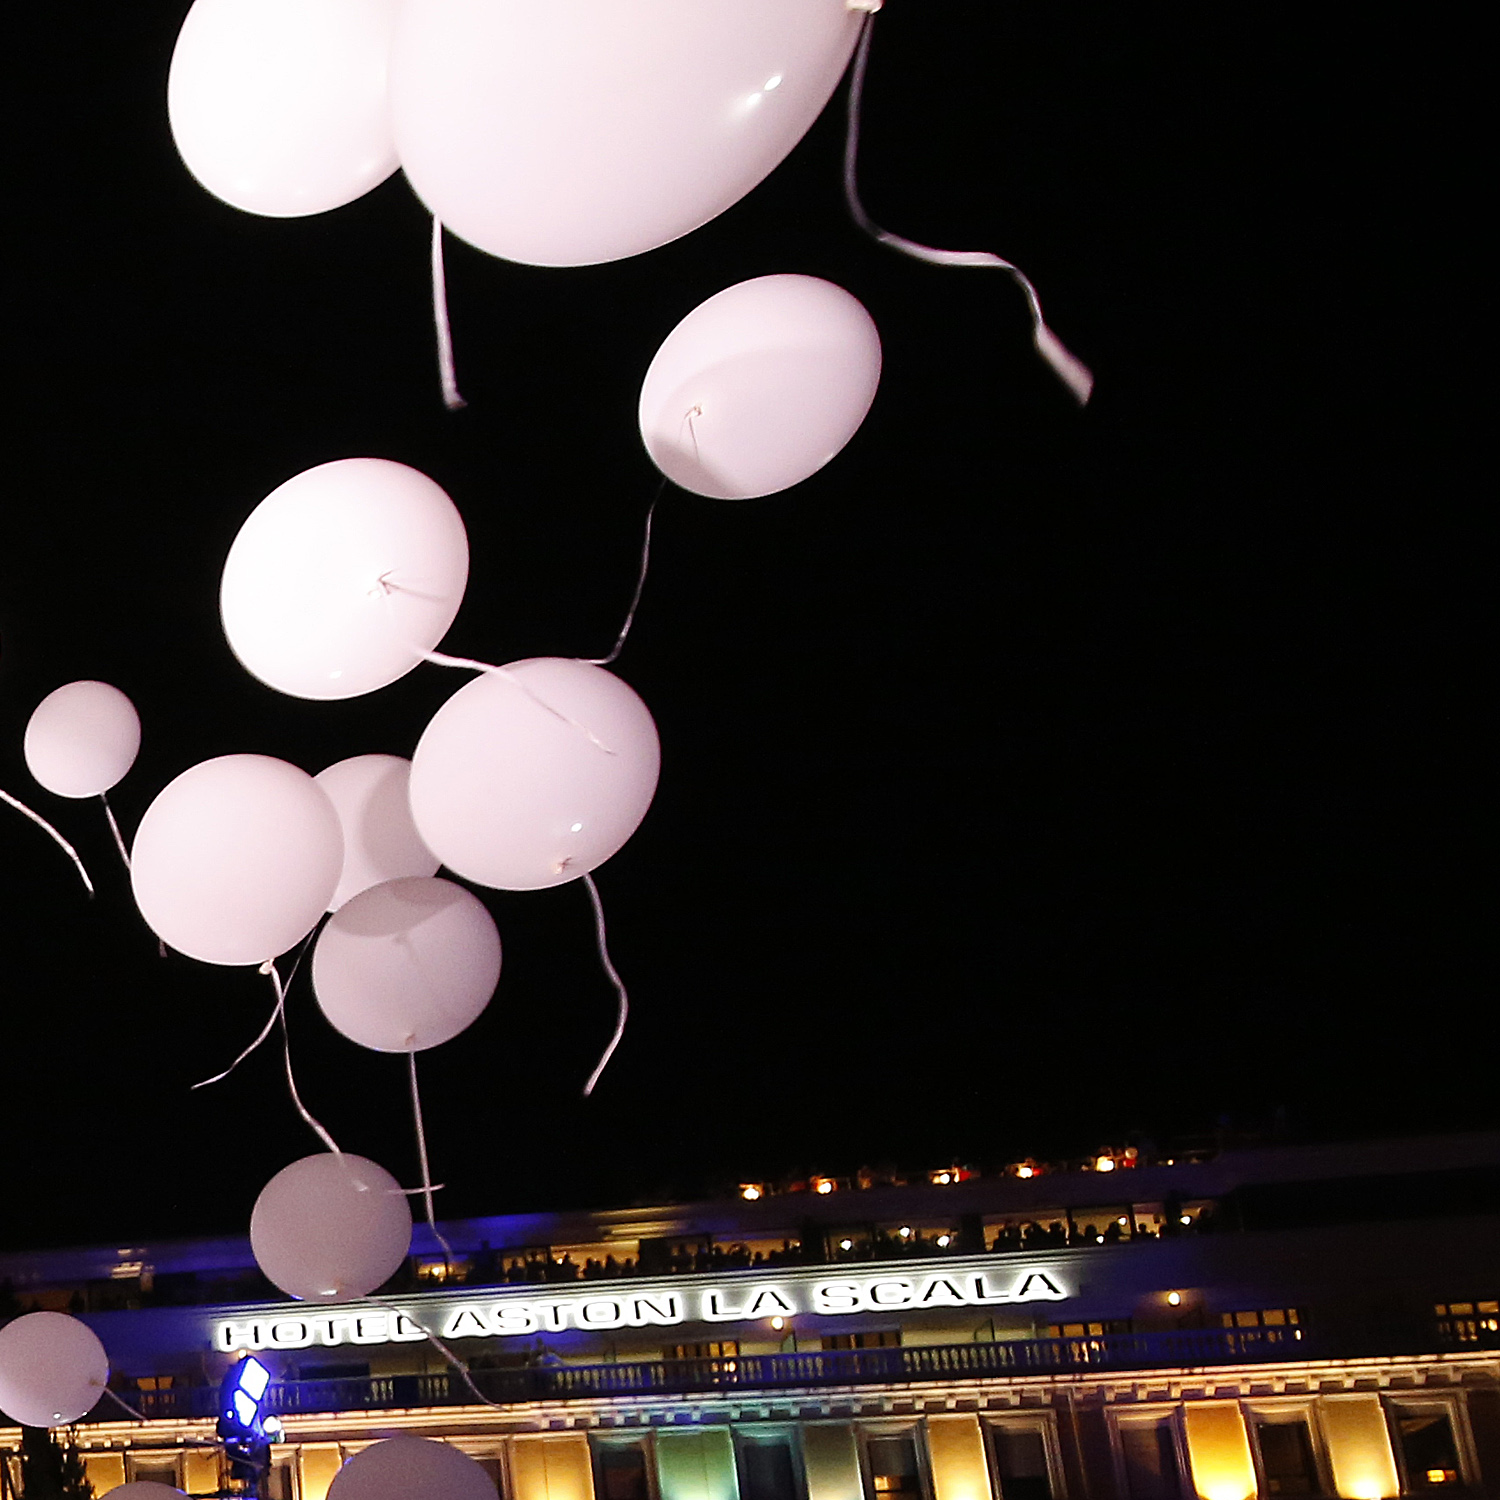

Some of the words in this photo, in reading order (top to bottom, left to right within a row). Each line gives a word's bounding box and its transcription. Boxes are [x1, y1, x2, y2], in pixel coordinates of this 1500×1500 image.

[223, 1311, 428, 1348] HOTEL
[449, 1295, 679, 1334] ASTON
[708, 1289, 792, 1317] LA
[818, 1271, 1065, 1310] SCALA
